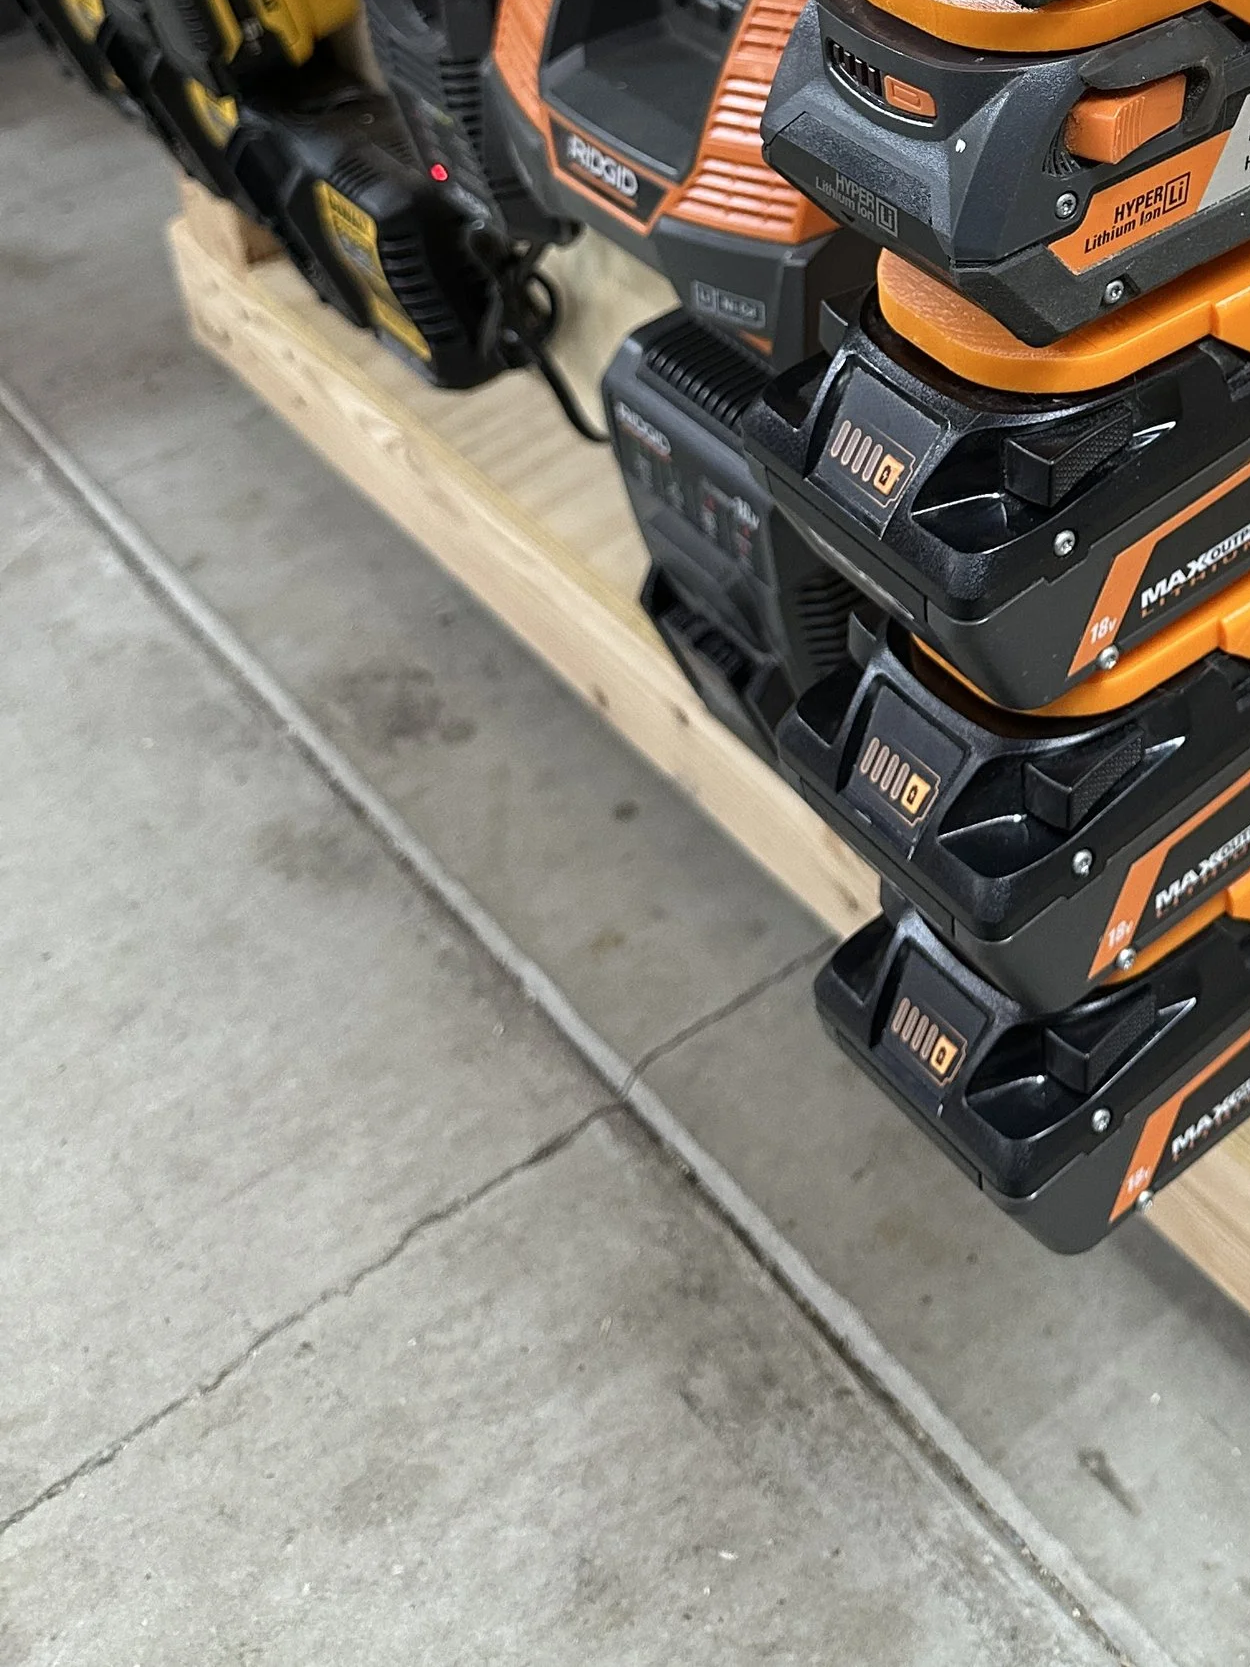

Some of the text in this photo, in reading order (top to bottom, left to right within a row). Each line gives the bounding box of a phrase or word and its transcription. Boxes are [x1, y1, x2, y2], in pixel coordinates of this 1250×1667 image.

[567, 134, 639, 197] RIDGID
[815, 176, 876, 224] Lithium Ion
[835, 171, 876, 210] HYPER
[1113, 184, 1164, 225] HYPER
[1084, 206, 1162, 255] Lithium Ion
